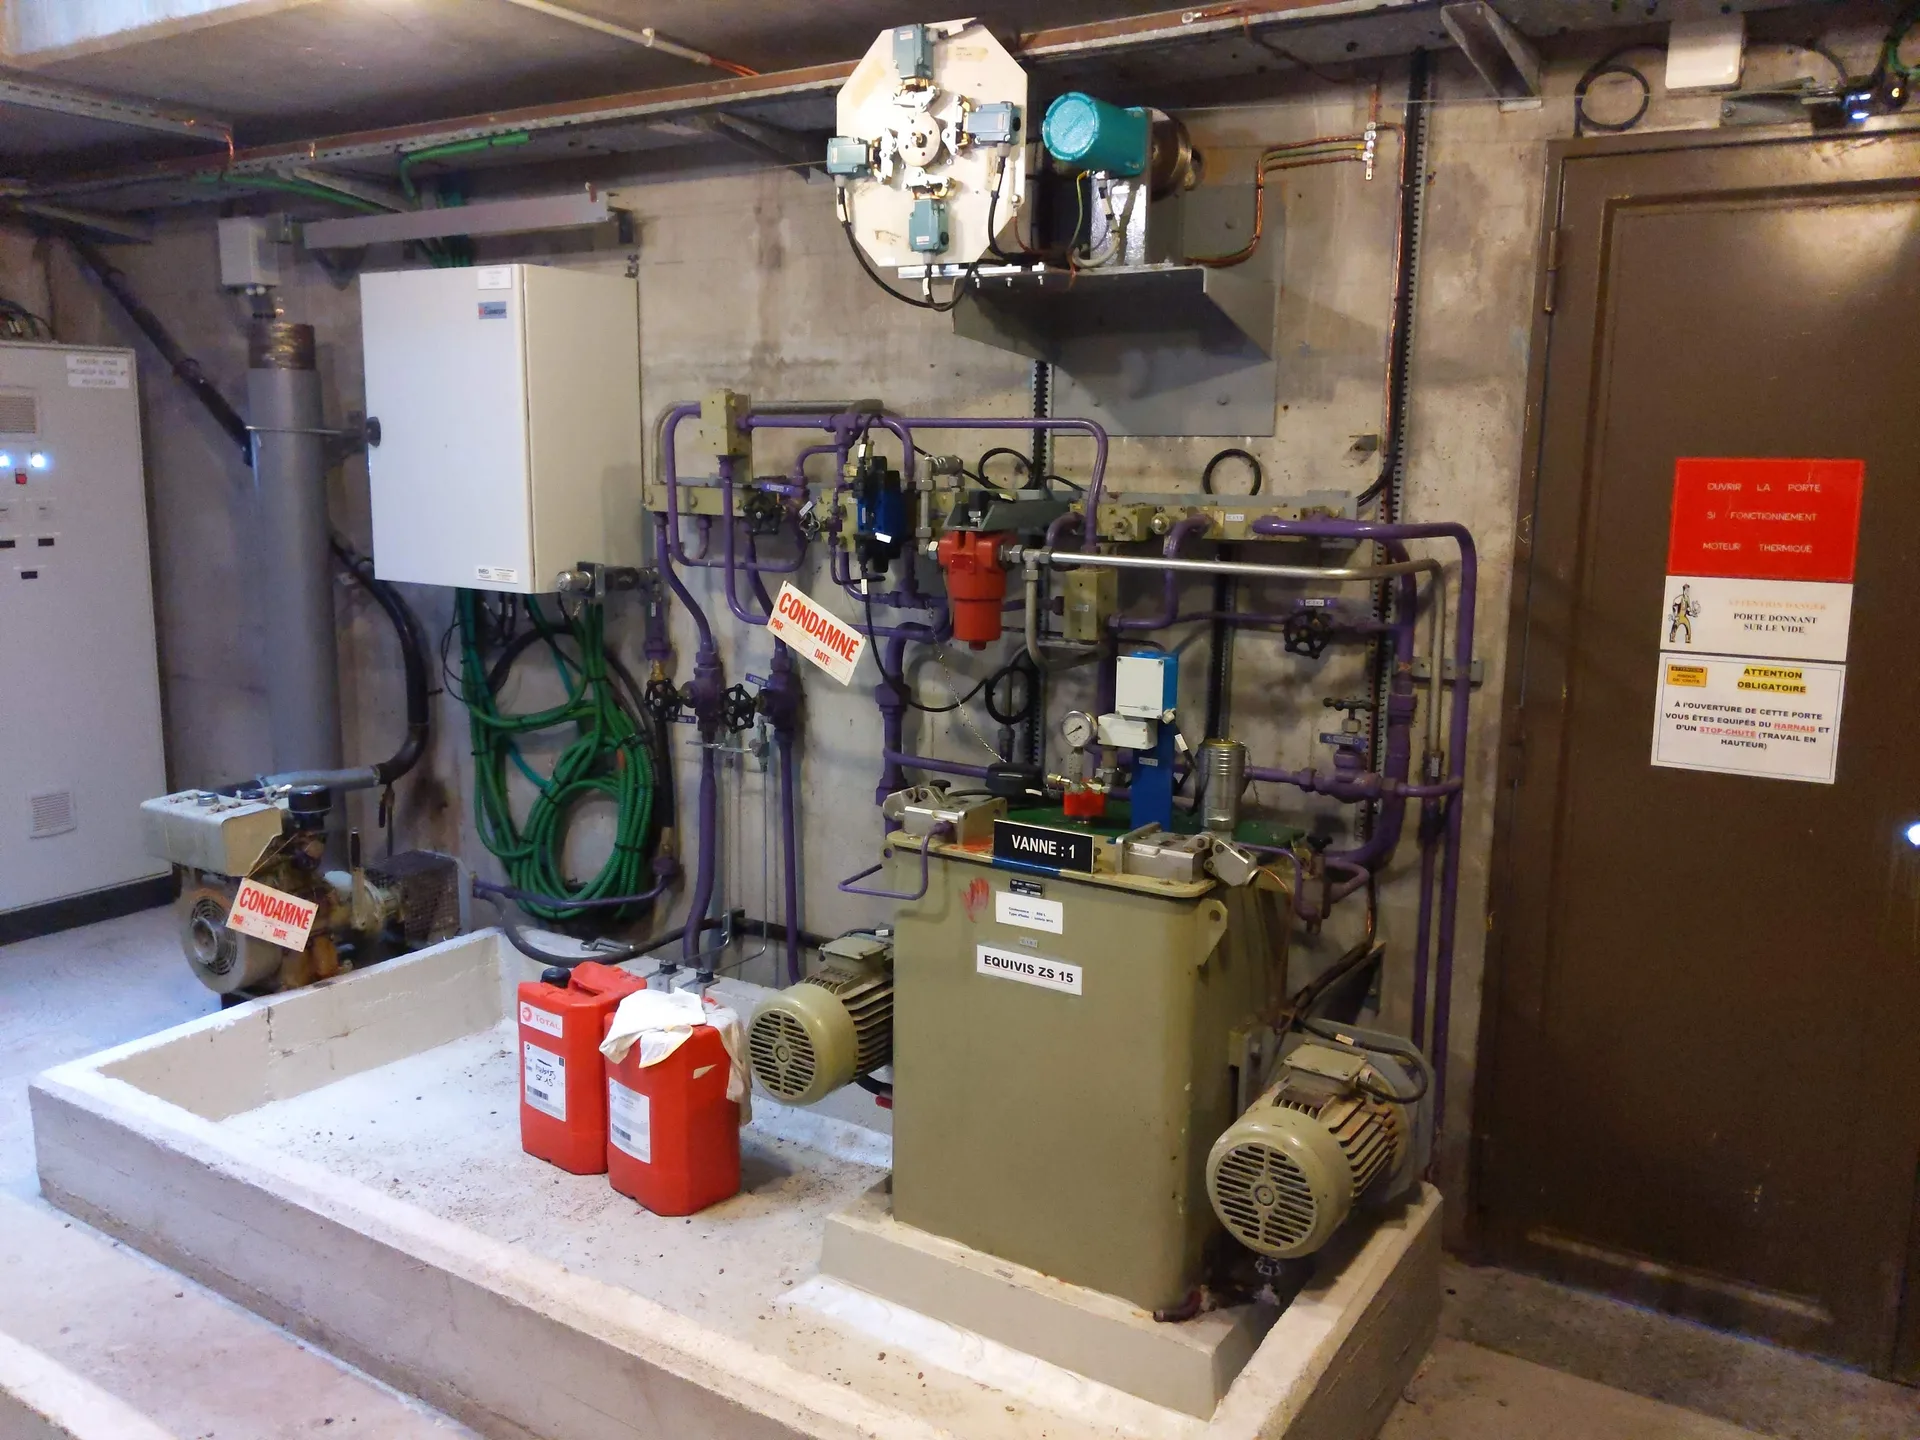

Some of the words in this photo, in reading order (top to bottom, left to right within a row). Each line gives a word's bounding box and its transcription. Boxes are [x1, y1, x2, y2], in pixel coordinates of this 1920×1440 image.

[1707, 483, 1742, 492] OUVRIR
[1756, 484, 1770, 492] LA
[1788, 484, 1821, 493] PORTE
[1707, 512, 1716, 520] SI
[1730, 512, 1817, 522] FONCTIONNEMENT
[1703, 542, 1741, 551] MOTEUR
[1759, 544, 1813, 554] THERMIQUE
[770, 617, 784, 632] PAR
[1733, 612, 1766, 622] PORTE
[1768, 614, 1818, 625] DONNANT
[1744, 623, 1763, 632] SUR
[1765, 624, 1778, 632] LE
[1781, 625, 1805, 634] VIDE
[814, 648, 830, 666] DATE
[1743, 668, 1803, 679] ATTENTION
[1737, 681, 1806, 693] OBLIGATOIRE
[1760, 708, 1789, 718] CETTE
[1791, 711, 1823, 720] PORTE
[1665, 713, 1690, 721] VOUS
[1773, 722, 1816, 733] HARNAIS
[1818, 726, 1830, 734] ET
[1676, 724, 1697, 732] D'UN
[1699, 726, 1757, 738] STOP-CHUTE
[1758, 732, 1801, 743] (TRAVAIL
[1720, 739, 1768, 750] HAUTEUR)
[1012, 834, 1057, 856] VANNE
[1068, 845, 1075, 859] 1
[273, 928, 288, 940] DATE
[984, 954, 1035, 975] EQUIVIS
[1038, 966, 1055, 979] ZS
[1058, 970, 1074, 983] 15
[535, 1014, 561, 1030] TOTAL
